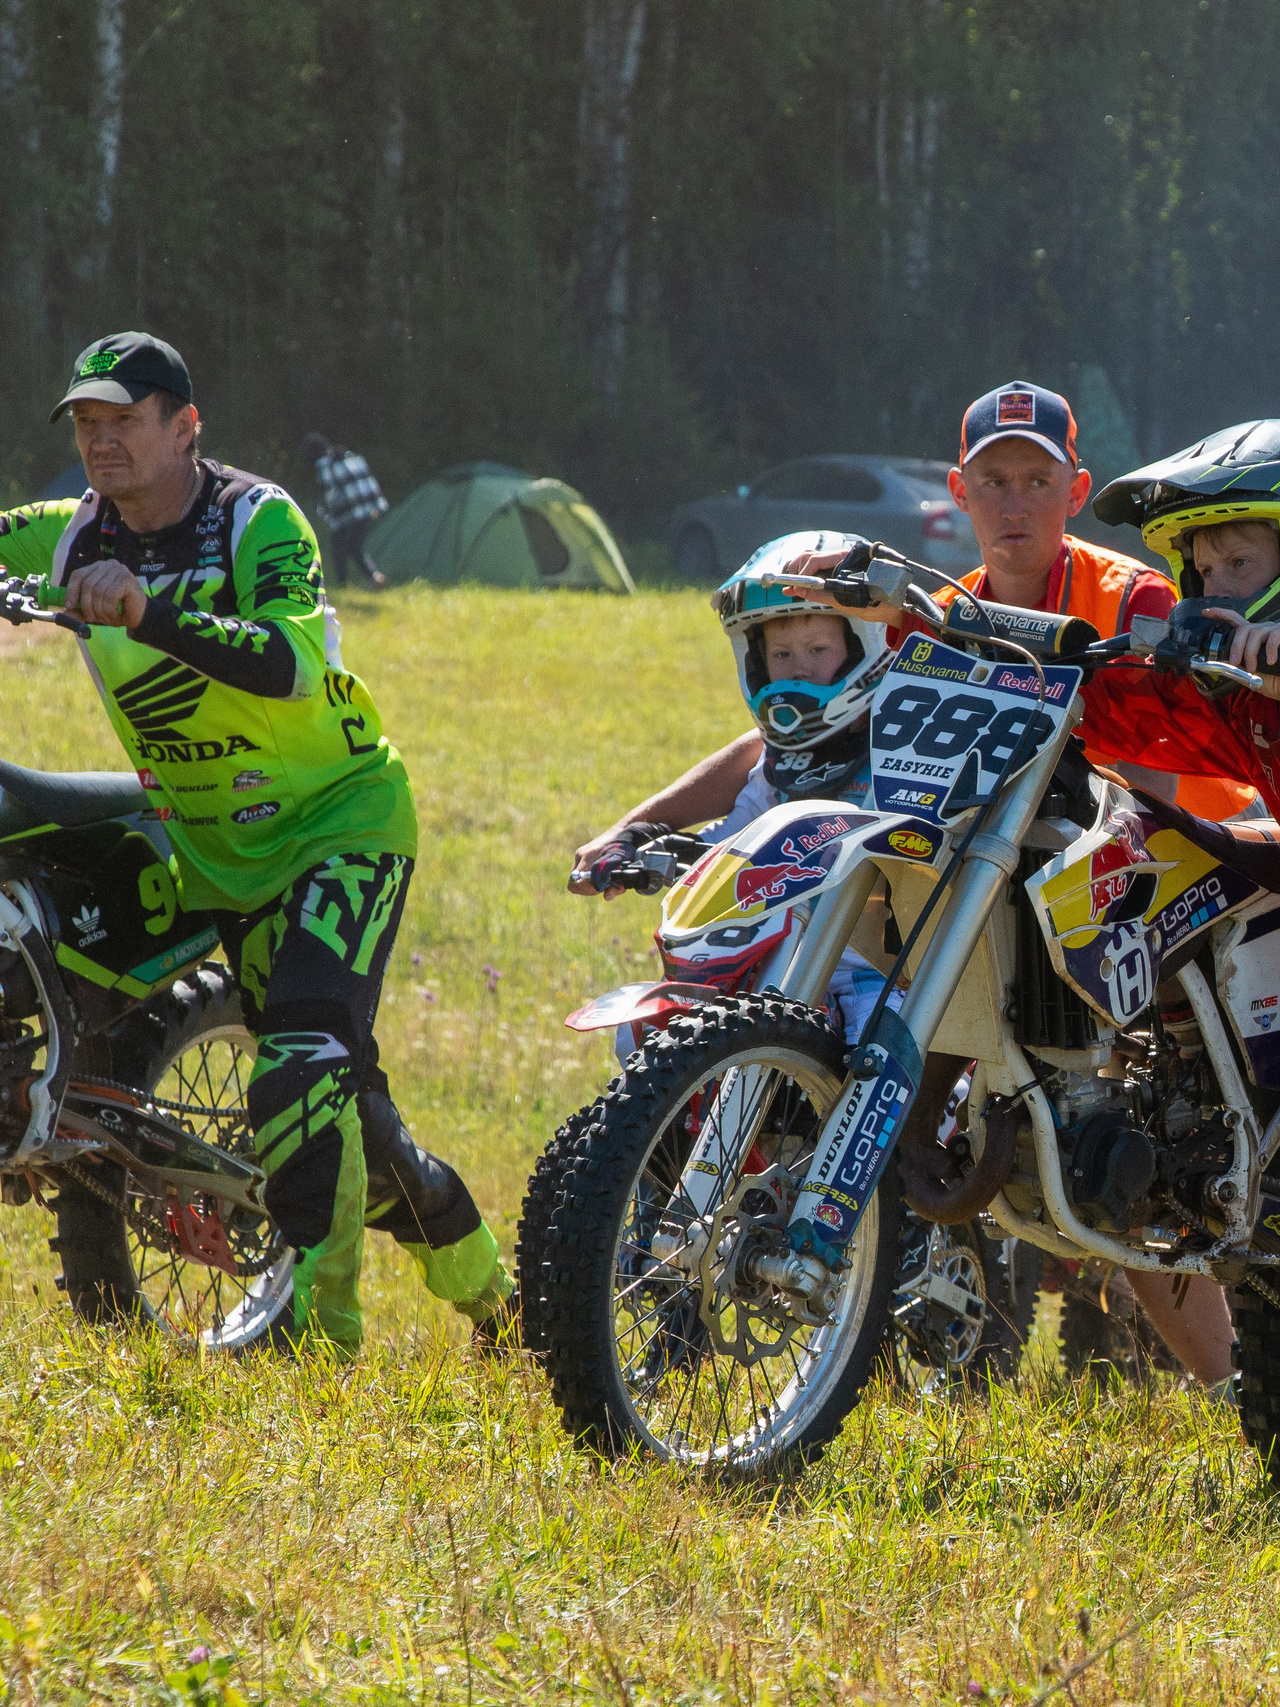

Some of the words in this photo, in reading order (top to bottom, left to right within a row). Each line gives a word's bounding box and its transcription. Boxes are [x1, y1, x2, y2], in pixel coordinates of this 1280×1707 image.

[979, 607, 1049, 632] usqvarna
[1009, 630, 1045, 641] MOTORCYCLES
[895, 658, 968, 682] Husqvarna
[872, 685, 1056, 777] 888
[131, 734, 262, 764] HONDA
[775, 752, 814, 771] 38
[879, 757, 955, 779] EASYHIE
[175, 783, 219, 793] DUNLOP
[889, 789, 937, 804] ANG
[884, 799, 934, 811] MOTOGRAPHICS
[889, 832, 933, 854] FMF
[138, 862, 176, 936] 9
[1161, 877, 1221, 931] GoPro
[78, 929, 108, 948] adidas
[818, 1082, 863, 1181] DUNLOP
[841, 1080, 897, 1185] GoPro
